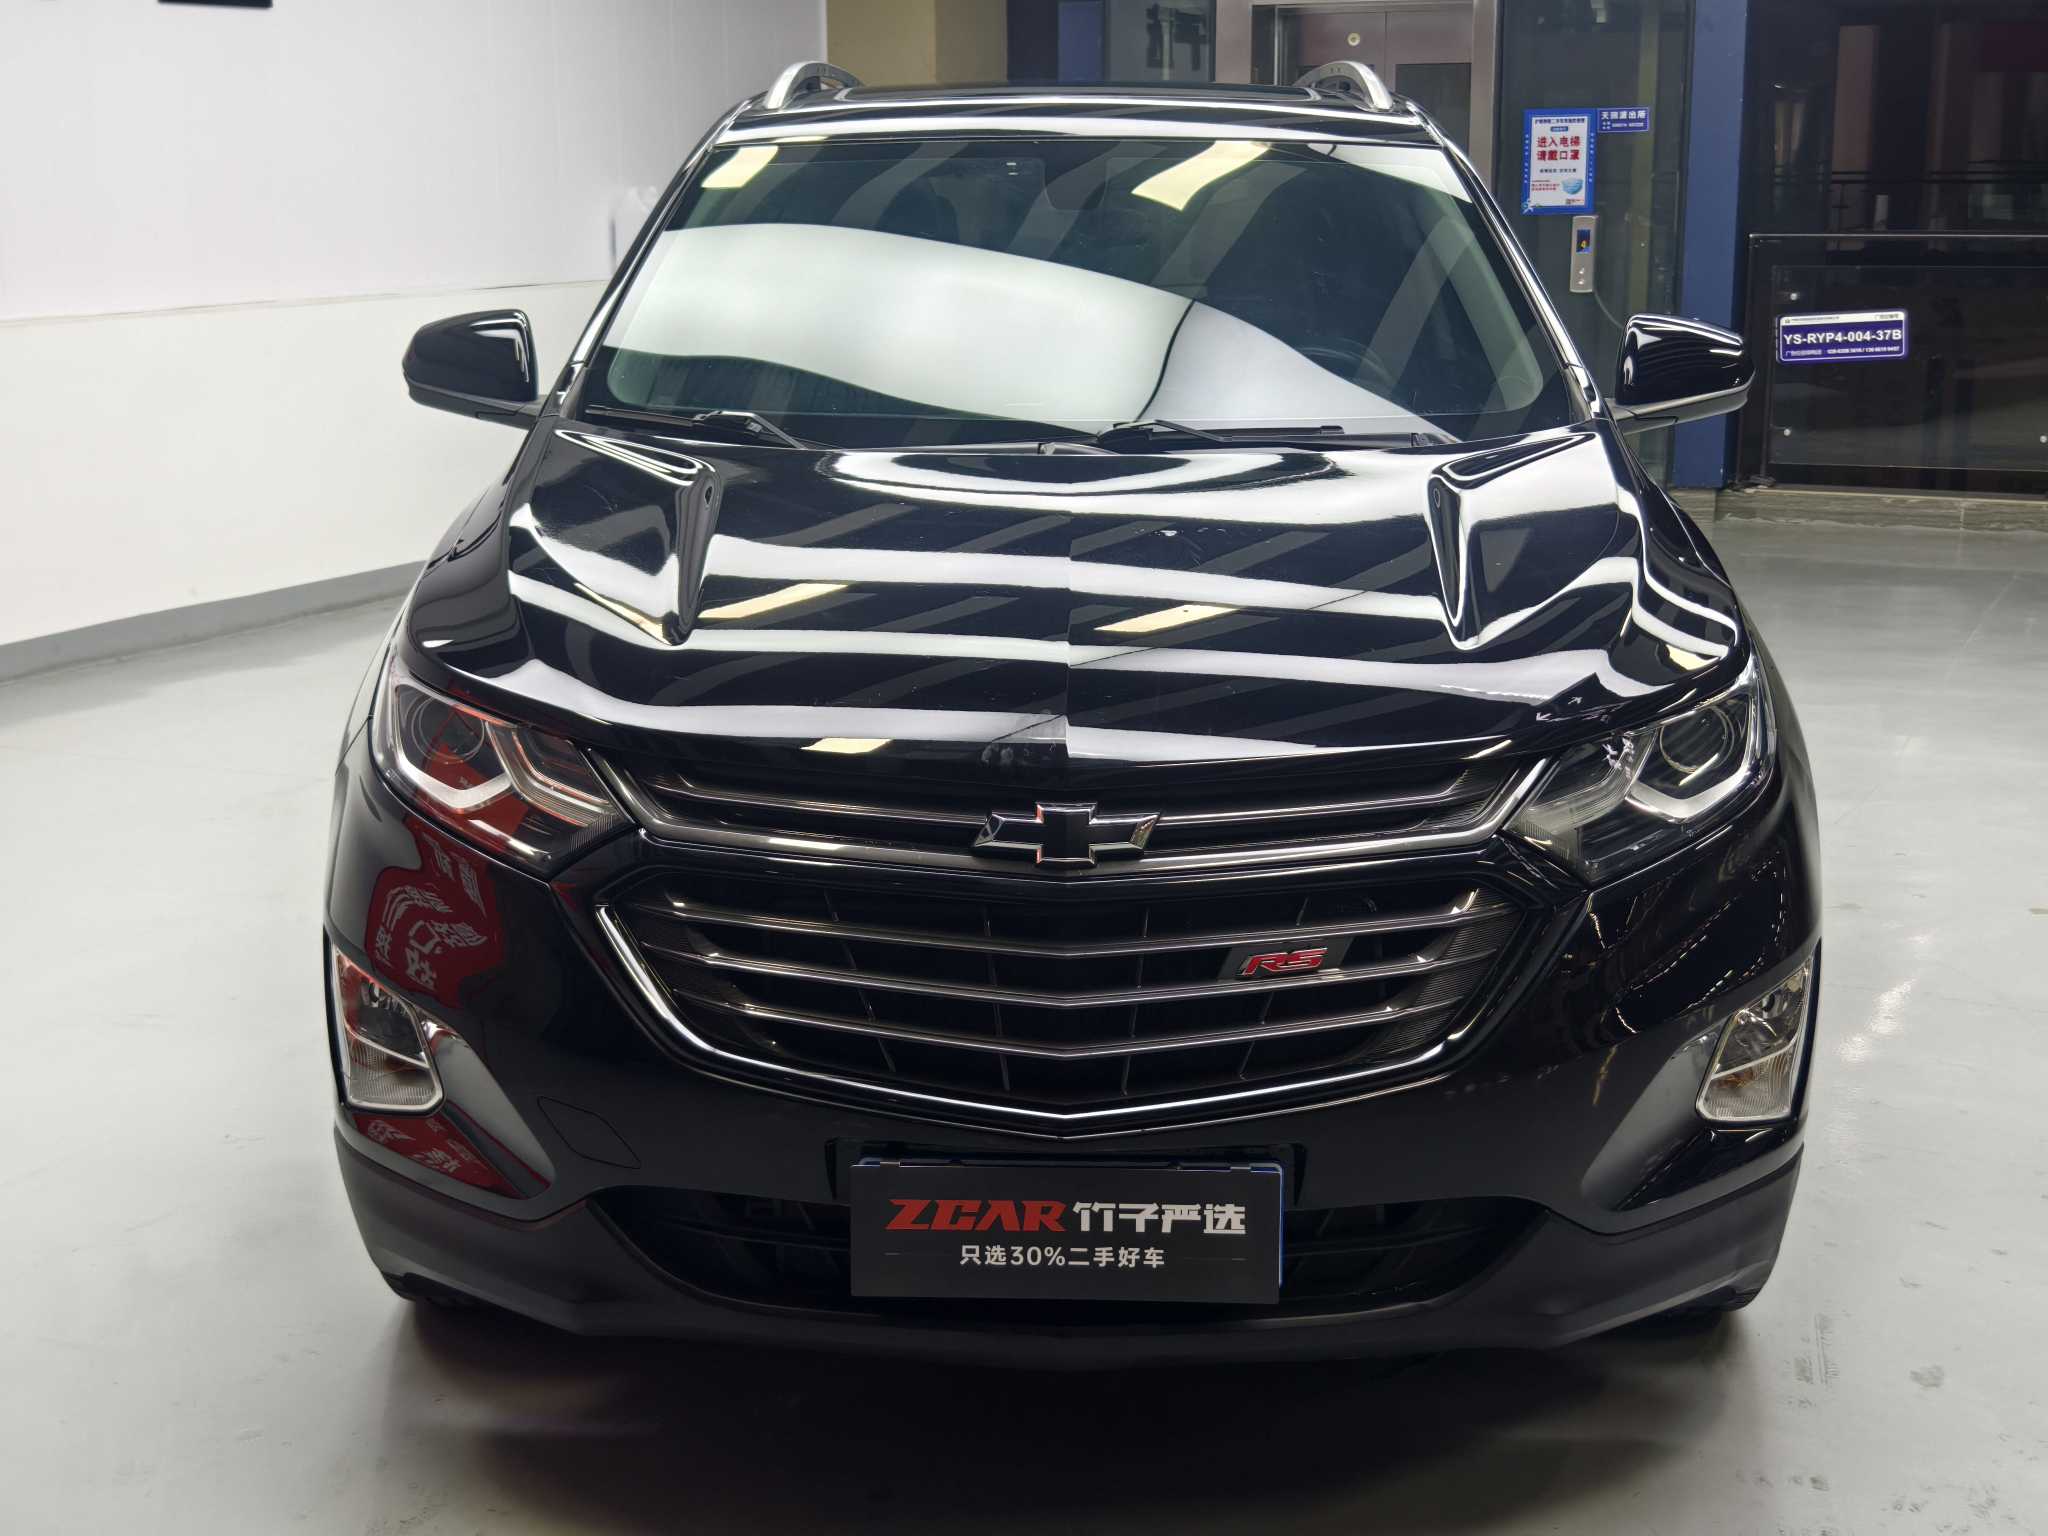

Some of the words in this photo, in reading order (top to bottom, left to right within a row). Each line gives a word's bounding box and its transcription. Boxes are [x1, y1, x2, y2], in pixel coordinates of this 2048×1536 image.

[1536, 136, 1580, 148] 进入电梯
[1536, 149, 1580, 161] 请戴口罩
[1783, 329, 1902, 345] YS-RYP4-004-37B
[1241, 947, 1329, 976] RS
[885, 1199, 1067, 1233] ZCAR
[1072, 1200, 1247, 1236] 竹子严选
[959, 1244, 1166, 1269] 只选30%二手好车
